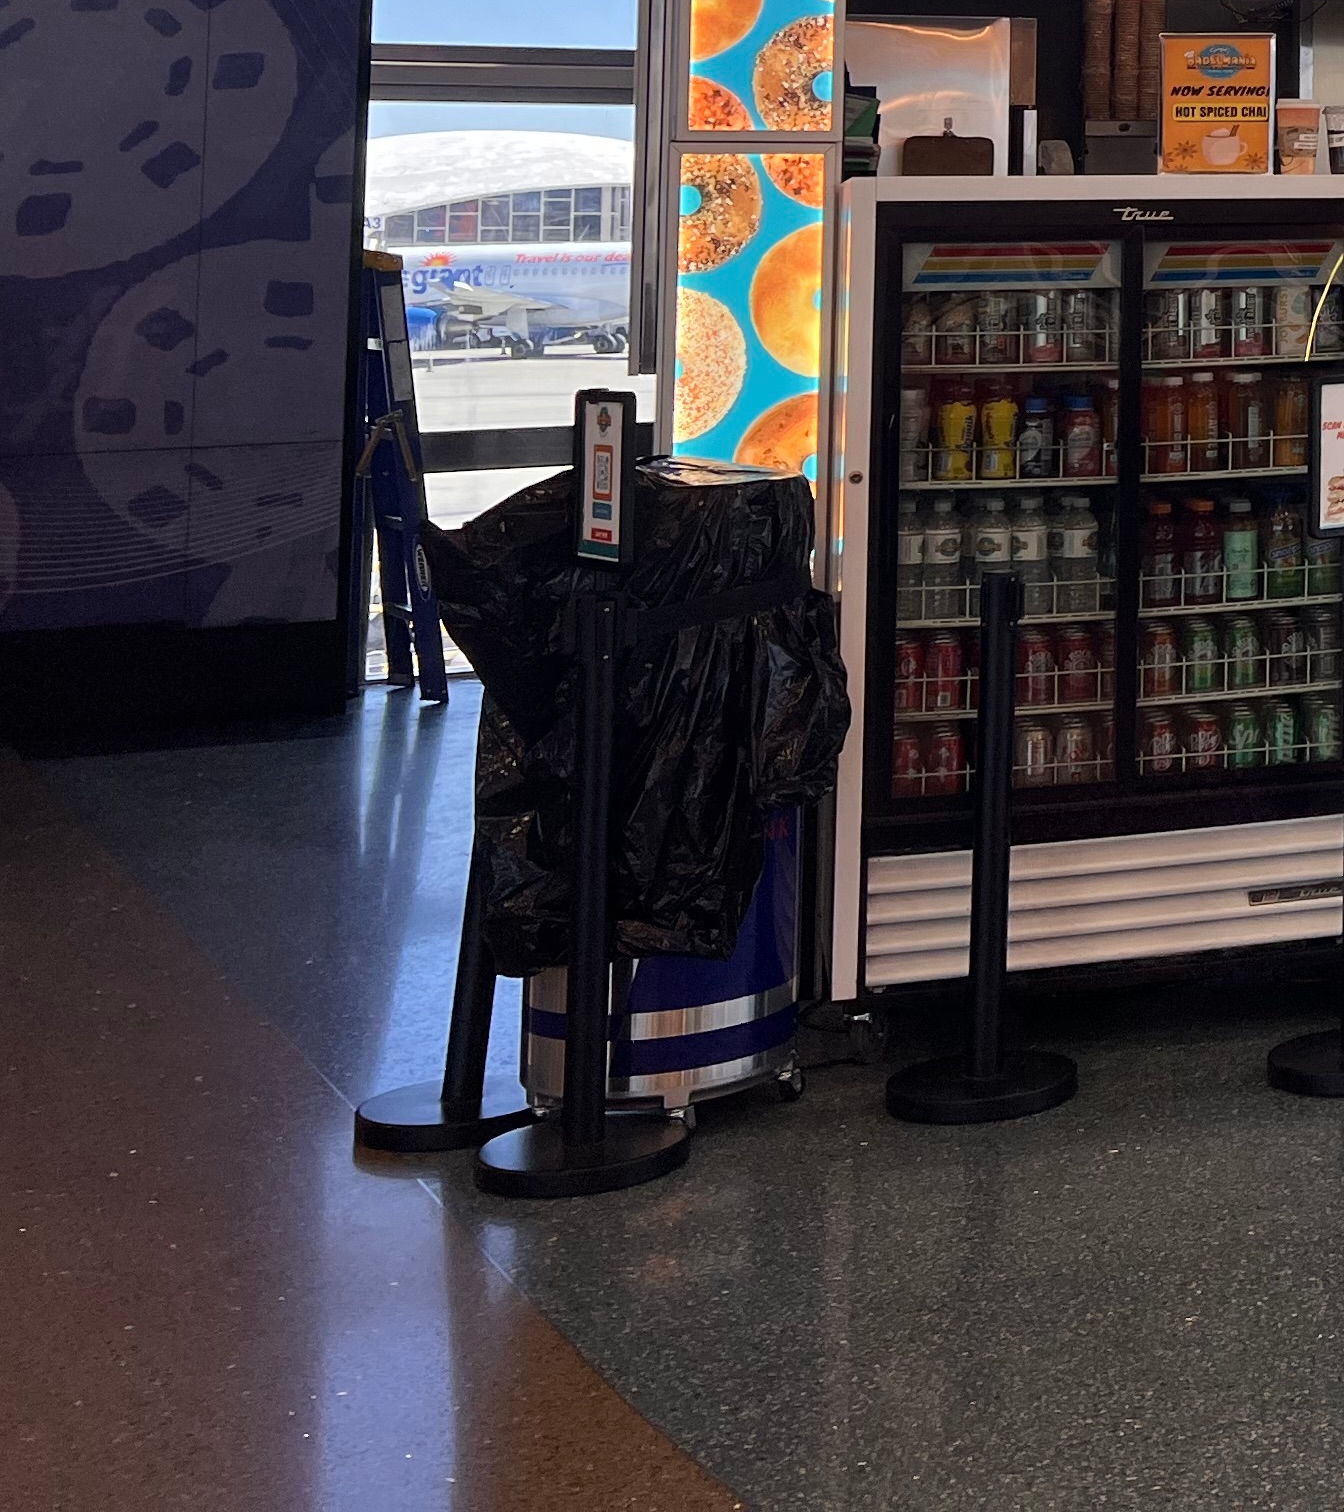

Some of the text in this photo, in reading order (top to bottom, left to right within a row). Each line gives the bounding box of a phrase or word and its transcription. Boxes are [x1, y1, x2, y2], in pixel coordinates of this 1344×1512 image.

[1171, 86, 1204, 96] NOW
[1176, 106, 1266, 117] HOT SPICED CHAI
[1112, 206, 1174, 220] true
[515, 252, 631, 264] Travel is our dea
[1322, 421, 1342, 431] SCAN
